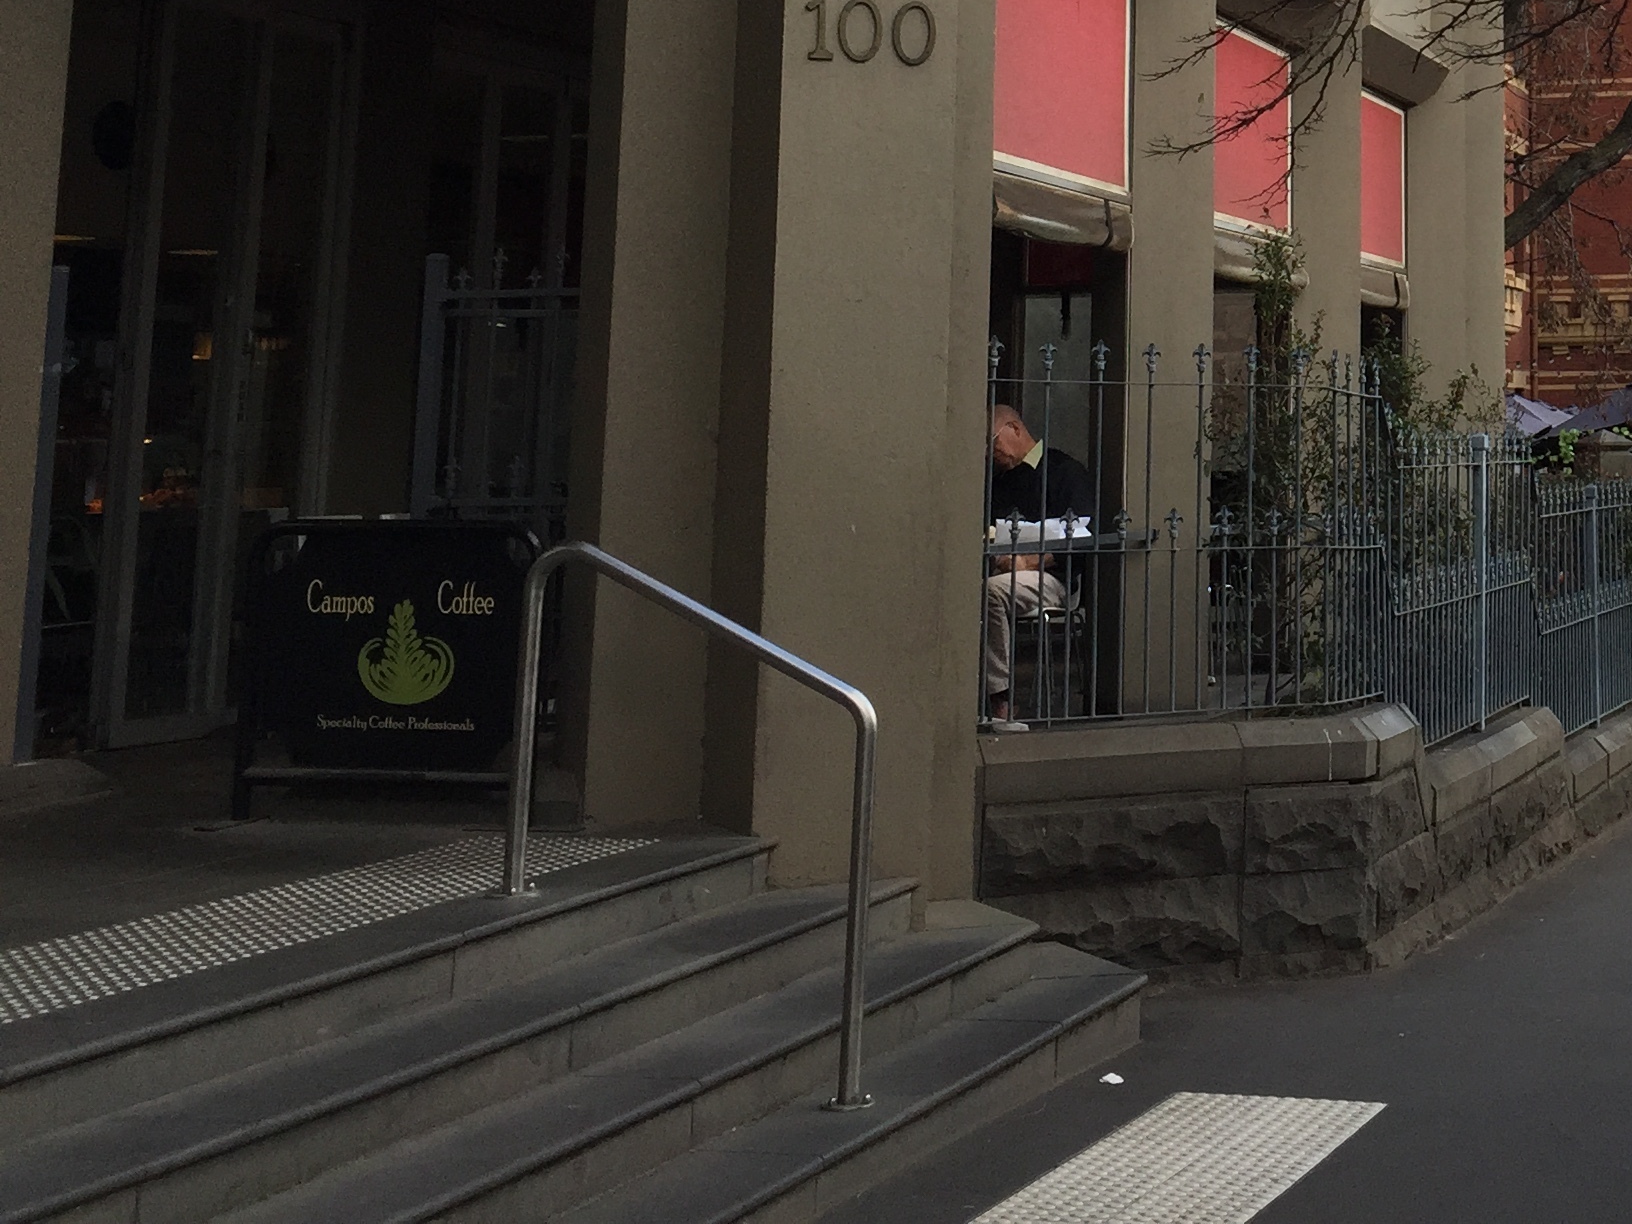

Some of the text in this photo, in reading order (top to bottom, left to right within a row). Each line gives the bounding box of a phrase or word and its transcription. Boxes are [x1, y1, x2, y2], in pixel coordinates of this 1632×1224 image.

[307, 579, 495, 621] Campos Coffee
[316, 714, 475, 732] Specialty Coffee Professionals
